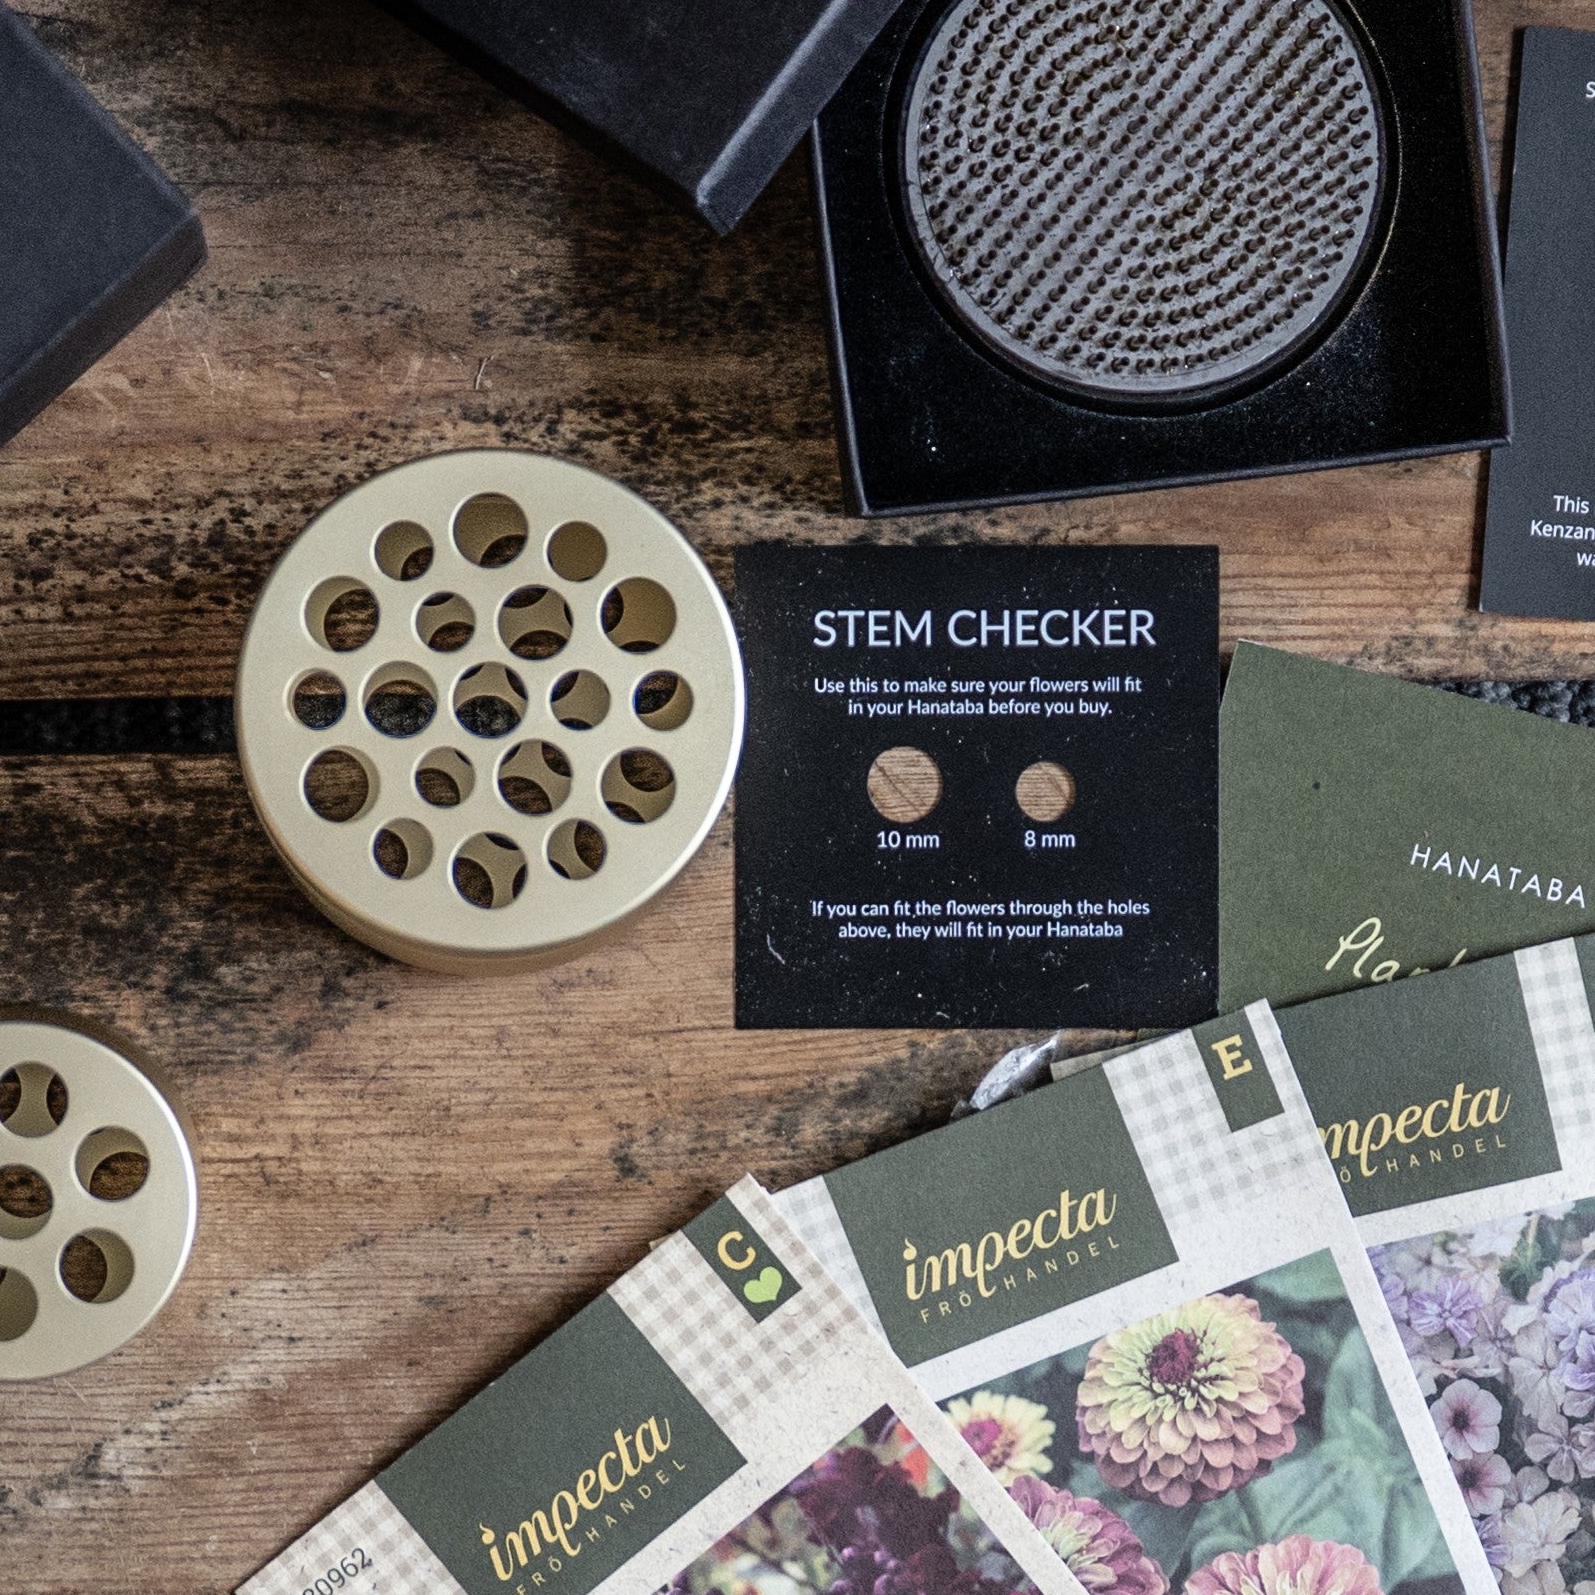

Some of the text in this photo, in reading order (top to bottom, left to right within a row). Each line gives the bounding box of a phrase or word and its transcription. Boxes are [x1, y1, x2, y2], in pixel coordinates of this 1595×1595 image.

[1552, 494, 1590, 515] This
[1530, 519, 1595, 541] Kenzan
[812, 608, 1157, 648] STEM CHECKER
[813, 675, 1143, 696] Use this to make sure your flowers will fit
[847, 697, 1113, 719] in your Hanataba before you buy.
[876, 830, 941, 850] 10 mm
[1023, 829, 1077, 850] 8 mm
[1411, 844, 1586, 910] HANATABA
[811, 898, 1151, 920] If you can fit the flowers through the holes
[837, 920, 1124, 941] above, they will fit in your Hanataba
[1212, 1034, 1254, 1081] E
[1317, 1082, 1511, 1177] mpecta
[1339, 1135, 1506, 1183] ÖHANDEL
[717, 1230, 756, 1271] C
[902, 1188, 1117, 1301] impecta
[920, 1236, 1120, 1324] FRÖHANDEL
[478, 1415, 672, 1582] impecta
